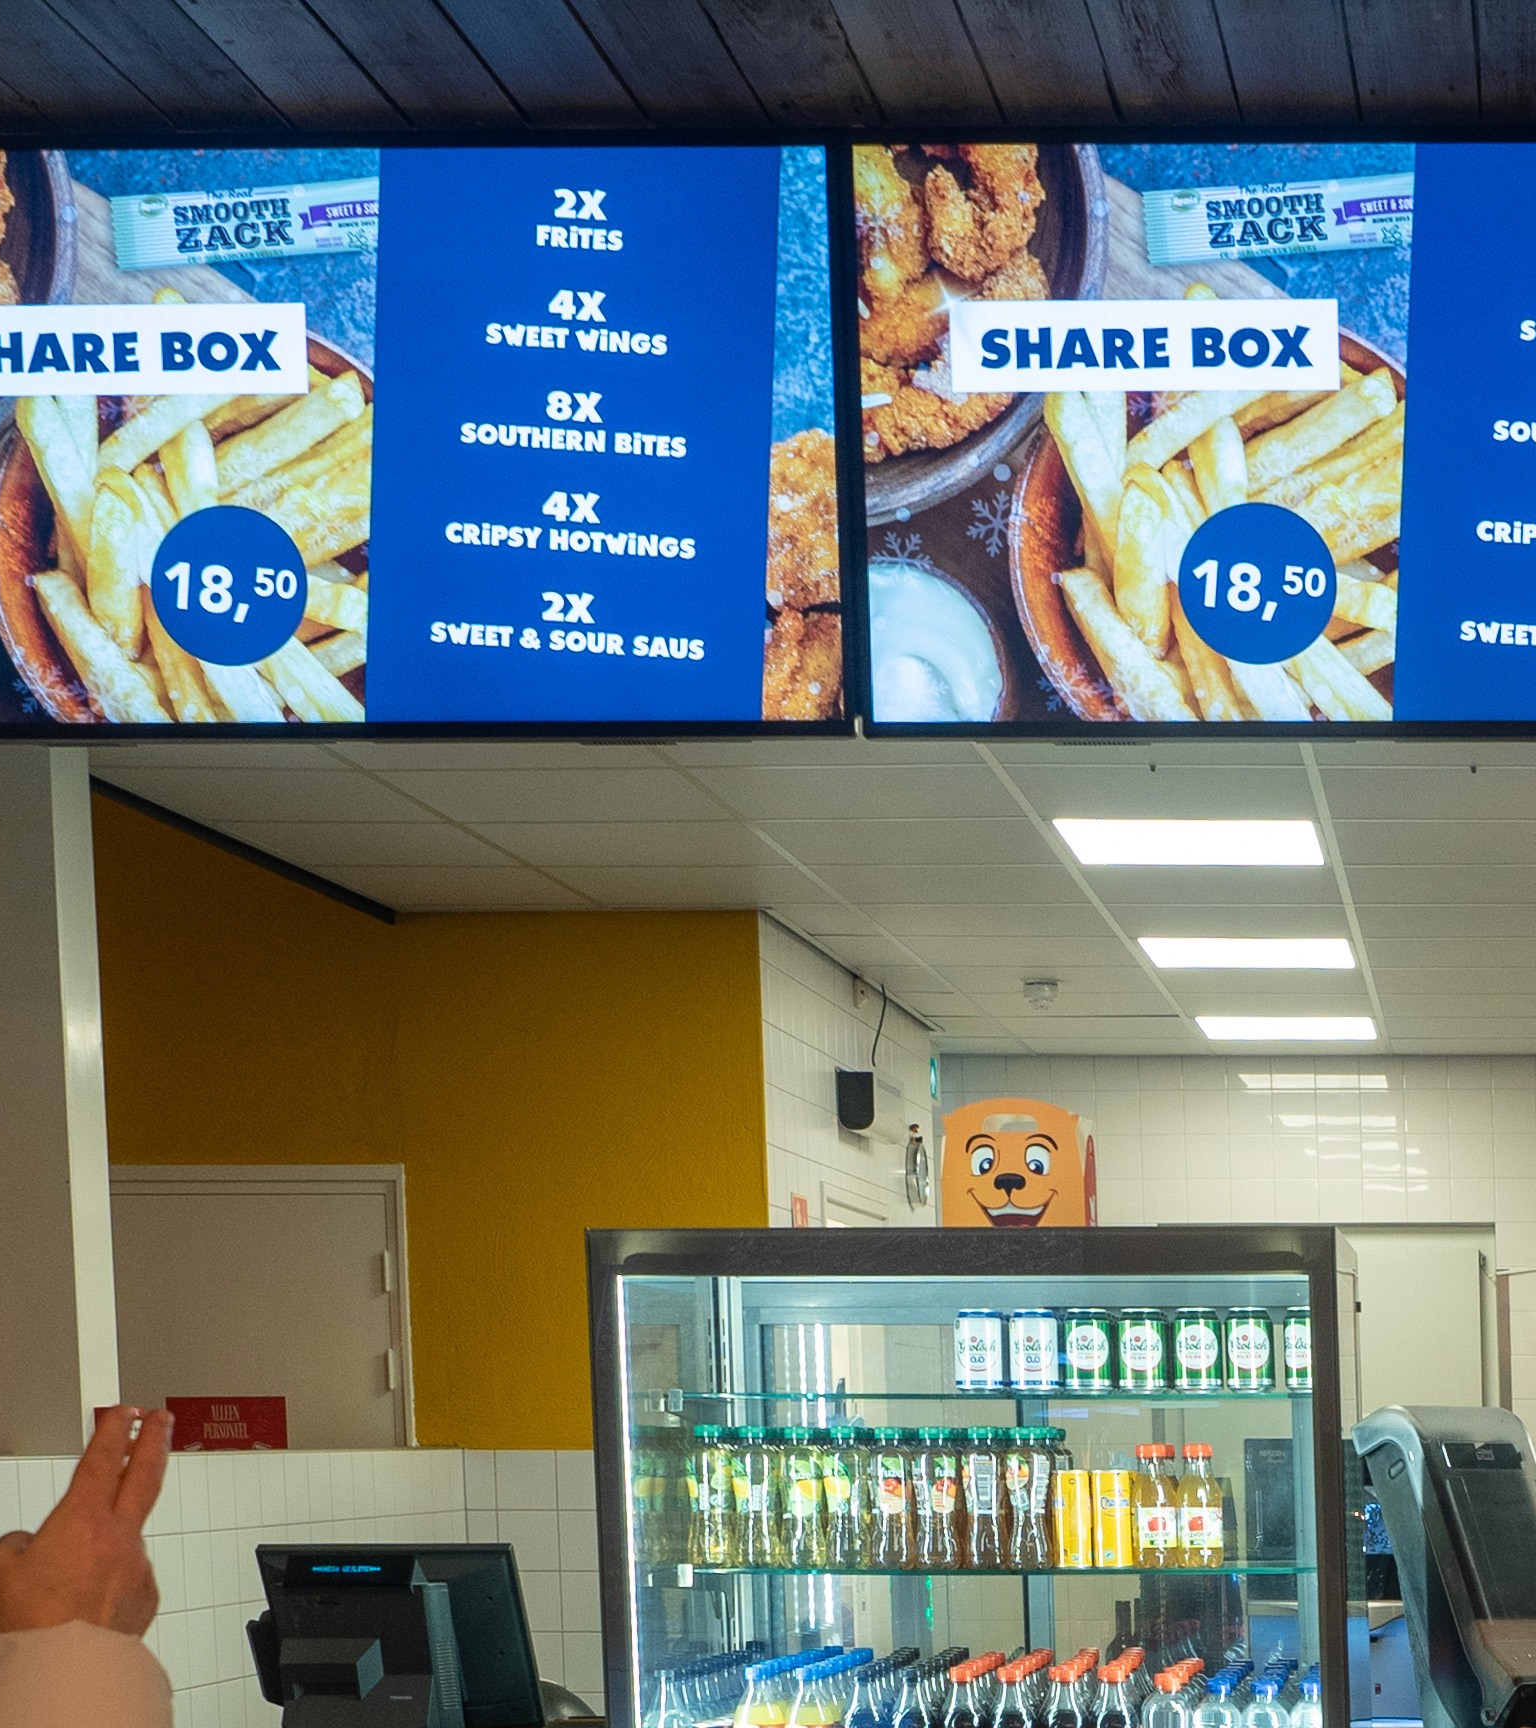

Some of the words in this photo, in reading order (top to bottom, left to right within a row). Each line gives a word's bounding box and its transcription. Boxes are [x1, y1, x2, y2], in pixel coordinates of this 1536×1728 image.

[174, 199, 291, 226] SMOOTH
[554, 189, 607, 220] 2X
[1206, 193, 1325, 221] SMOOTH
[176, 220, 294, 253] ZACK
[1208, 215, 1328, 247] ZACK
[549, 290, 606, 322] 4X
[161, 330, 281, 372] BOX
[486, 323, 569, 348] SWEET
[981, 327, 1170, 369] SHARE
[1192, 325, 1313, 368] BOX
[546, 391, 603, 423] 8X
[461, 423, 606, 452] SOUTHERN
[543, 491, 600, 523] 4X
[542, 592, 595, 623] 2X
[431, 622, 514, 647] SWEET
[519, 628, 541, 650] &
[549, 630, 625, 655] SOUR
[633, 636, 704, 660] SAUS
[211, 1404, 240, 1421] ALLEEN
[203, 1422, 249, 1439] PERSONEEL
